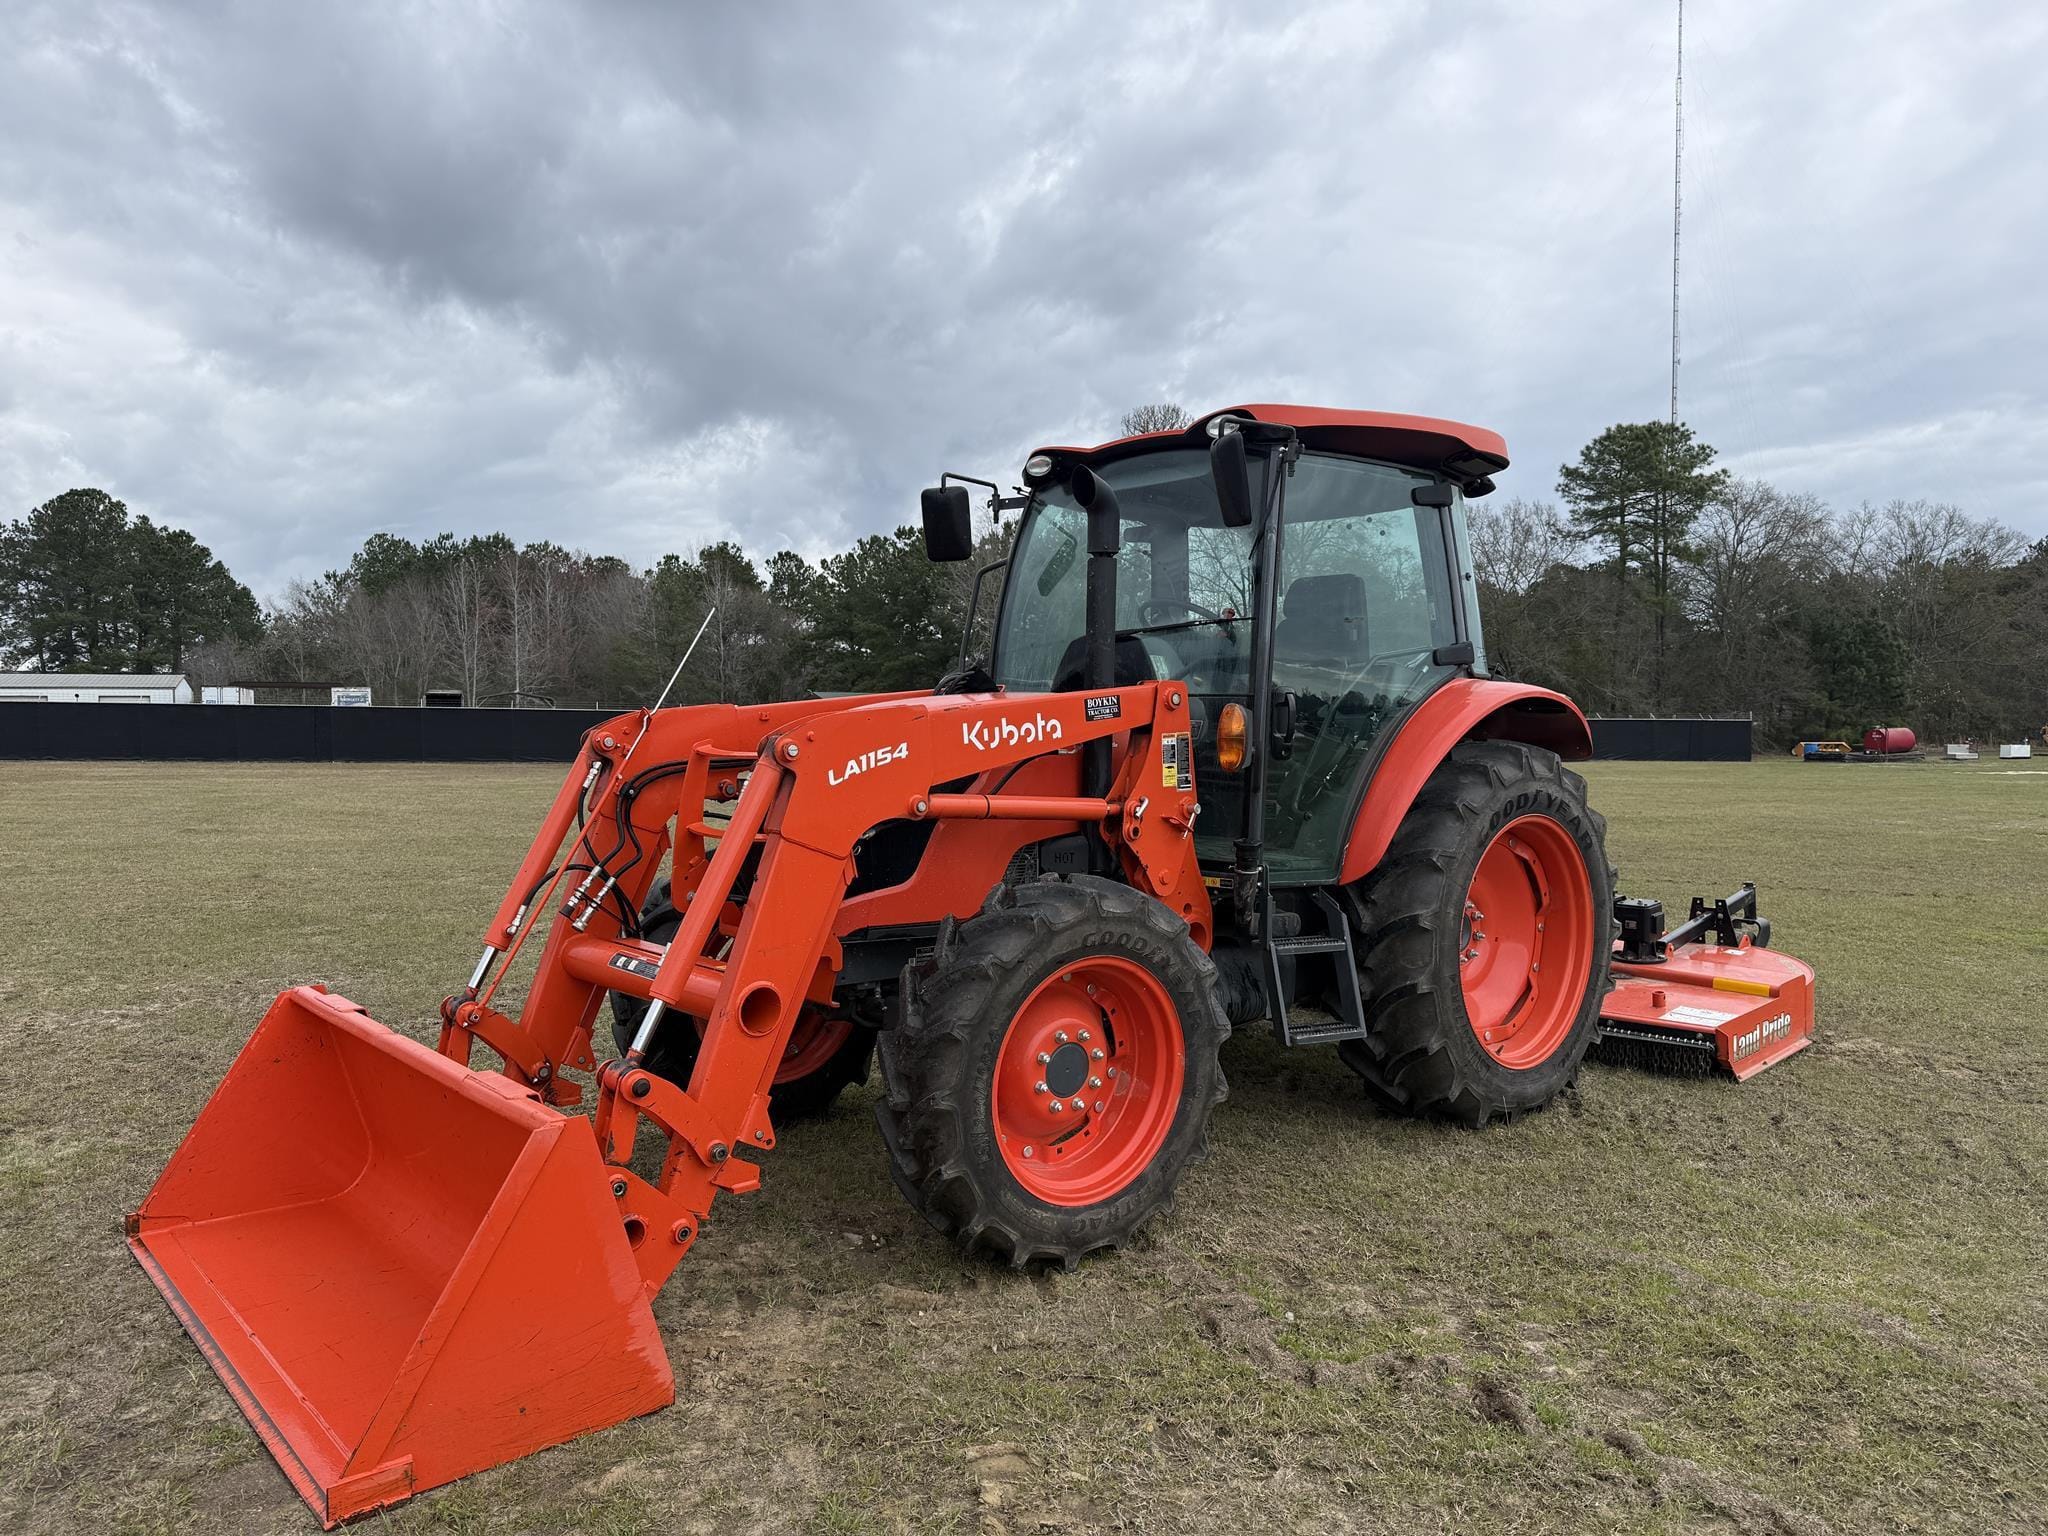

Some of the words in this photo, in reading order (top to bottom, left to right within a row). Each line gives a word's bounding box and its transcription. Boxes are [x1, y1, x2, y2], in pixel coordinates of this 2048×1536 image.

[1087, 696, 1117, 708] BOYKIN
[1088, 708, 1110, 716] TRACTOR
[962, 712, 1062, 751] Kubota
[828, 742, 909, 787] LA1154
[1054, 852, 1075, 864] HOT
[1733, 1023, 1760, 1063] Land
[1762, 1011, 1791, 1048] Pride
